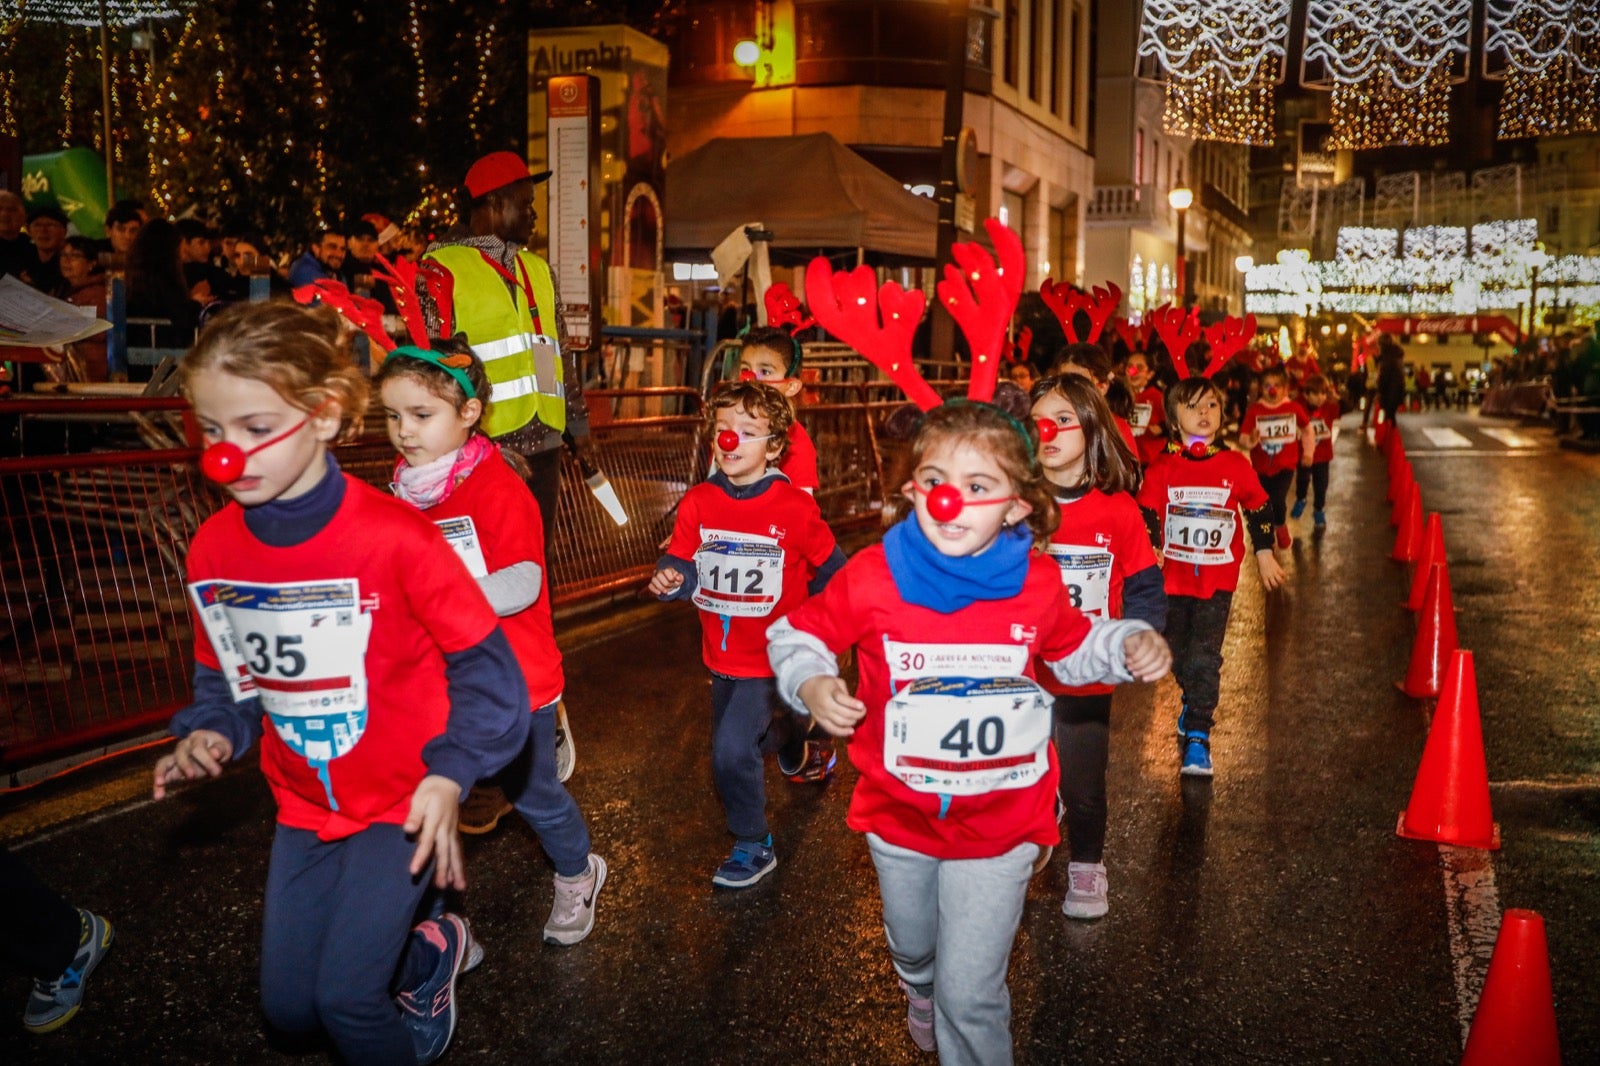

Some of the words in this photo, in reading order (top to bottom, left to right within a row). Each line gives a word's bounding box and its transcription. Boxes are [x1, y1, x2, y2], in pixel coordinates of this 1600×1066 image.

[1265, 424, 1289, 438] 120
[1174, 490, 1185, 500] 30
[1179, 526, 1222, 548] 109
[709, 565, 763, 594] 112
[245, 632, 306, 677] 35
[899, 652, 925, 671] 30
[940, 715, 1004, 758] 40
